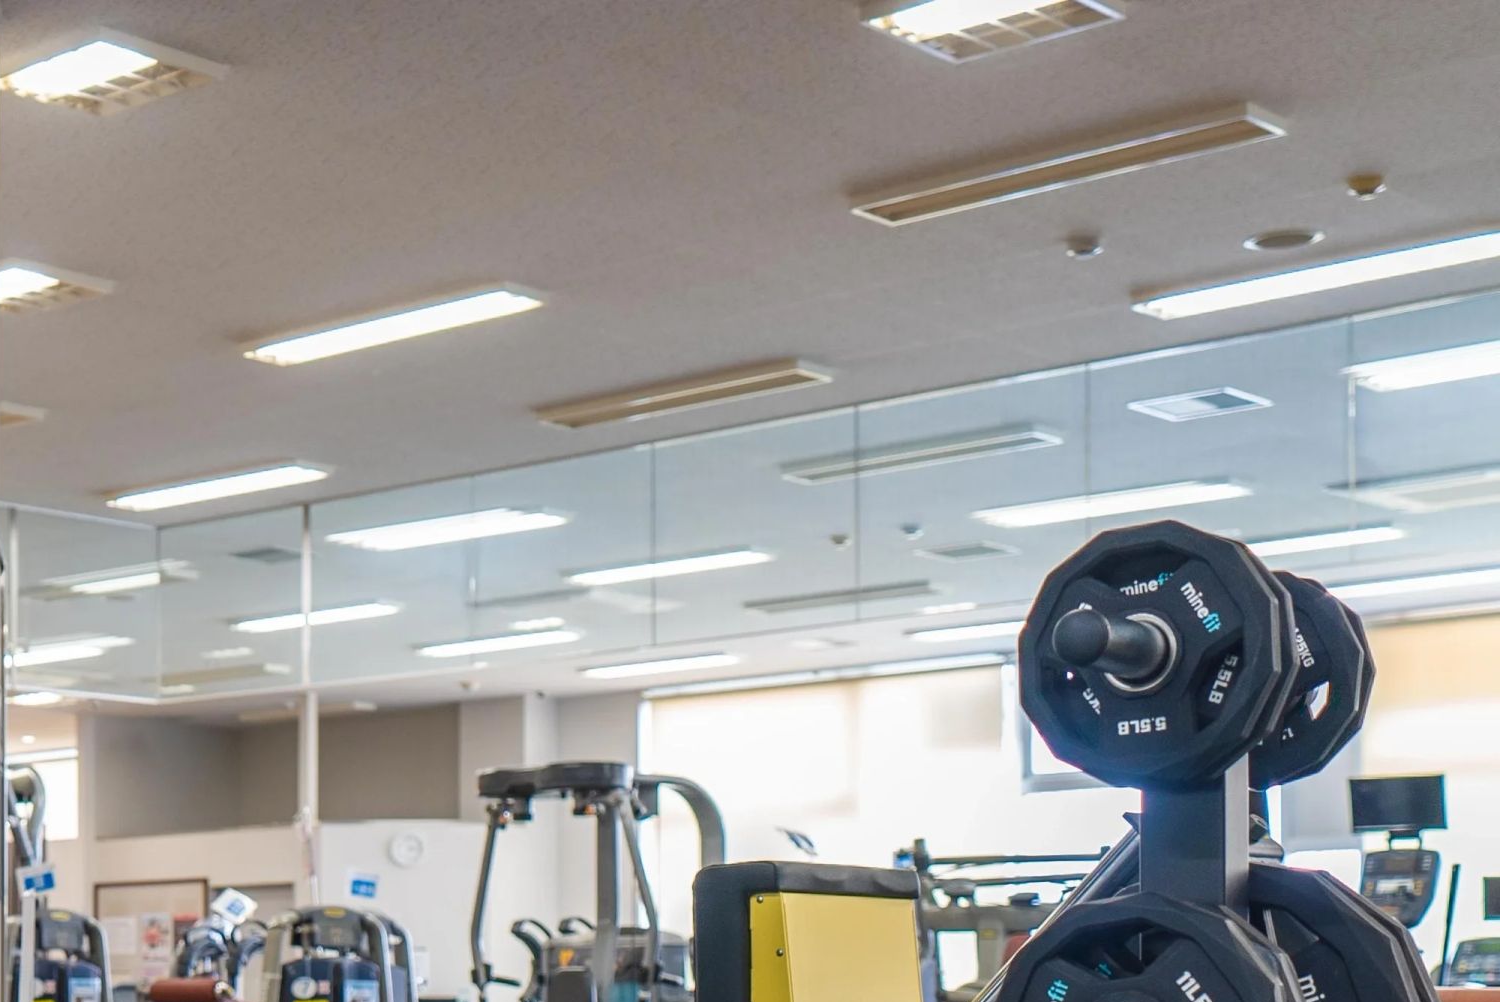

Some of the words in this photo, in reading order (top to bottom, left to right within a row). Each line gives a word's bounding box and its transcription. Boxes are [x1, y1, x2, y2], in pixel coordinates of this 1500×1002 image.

[1120, 572, 1174, 596] minef
[1180, 582, 1222, 633] minefit
[1208, 654, 1238, 704] 5.5LB
[1117, 716, 1167, 736] 5.5LB
